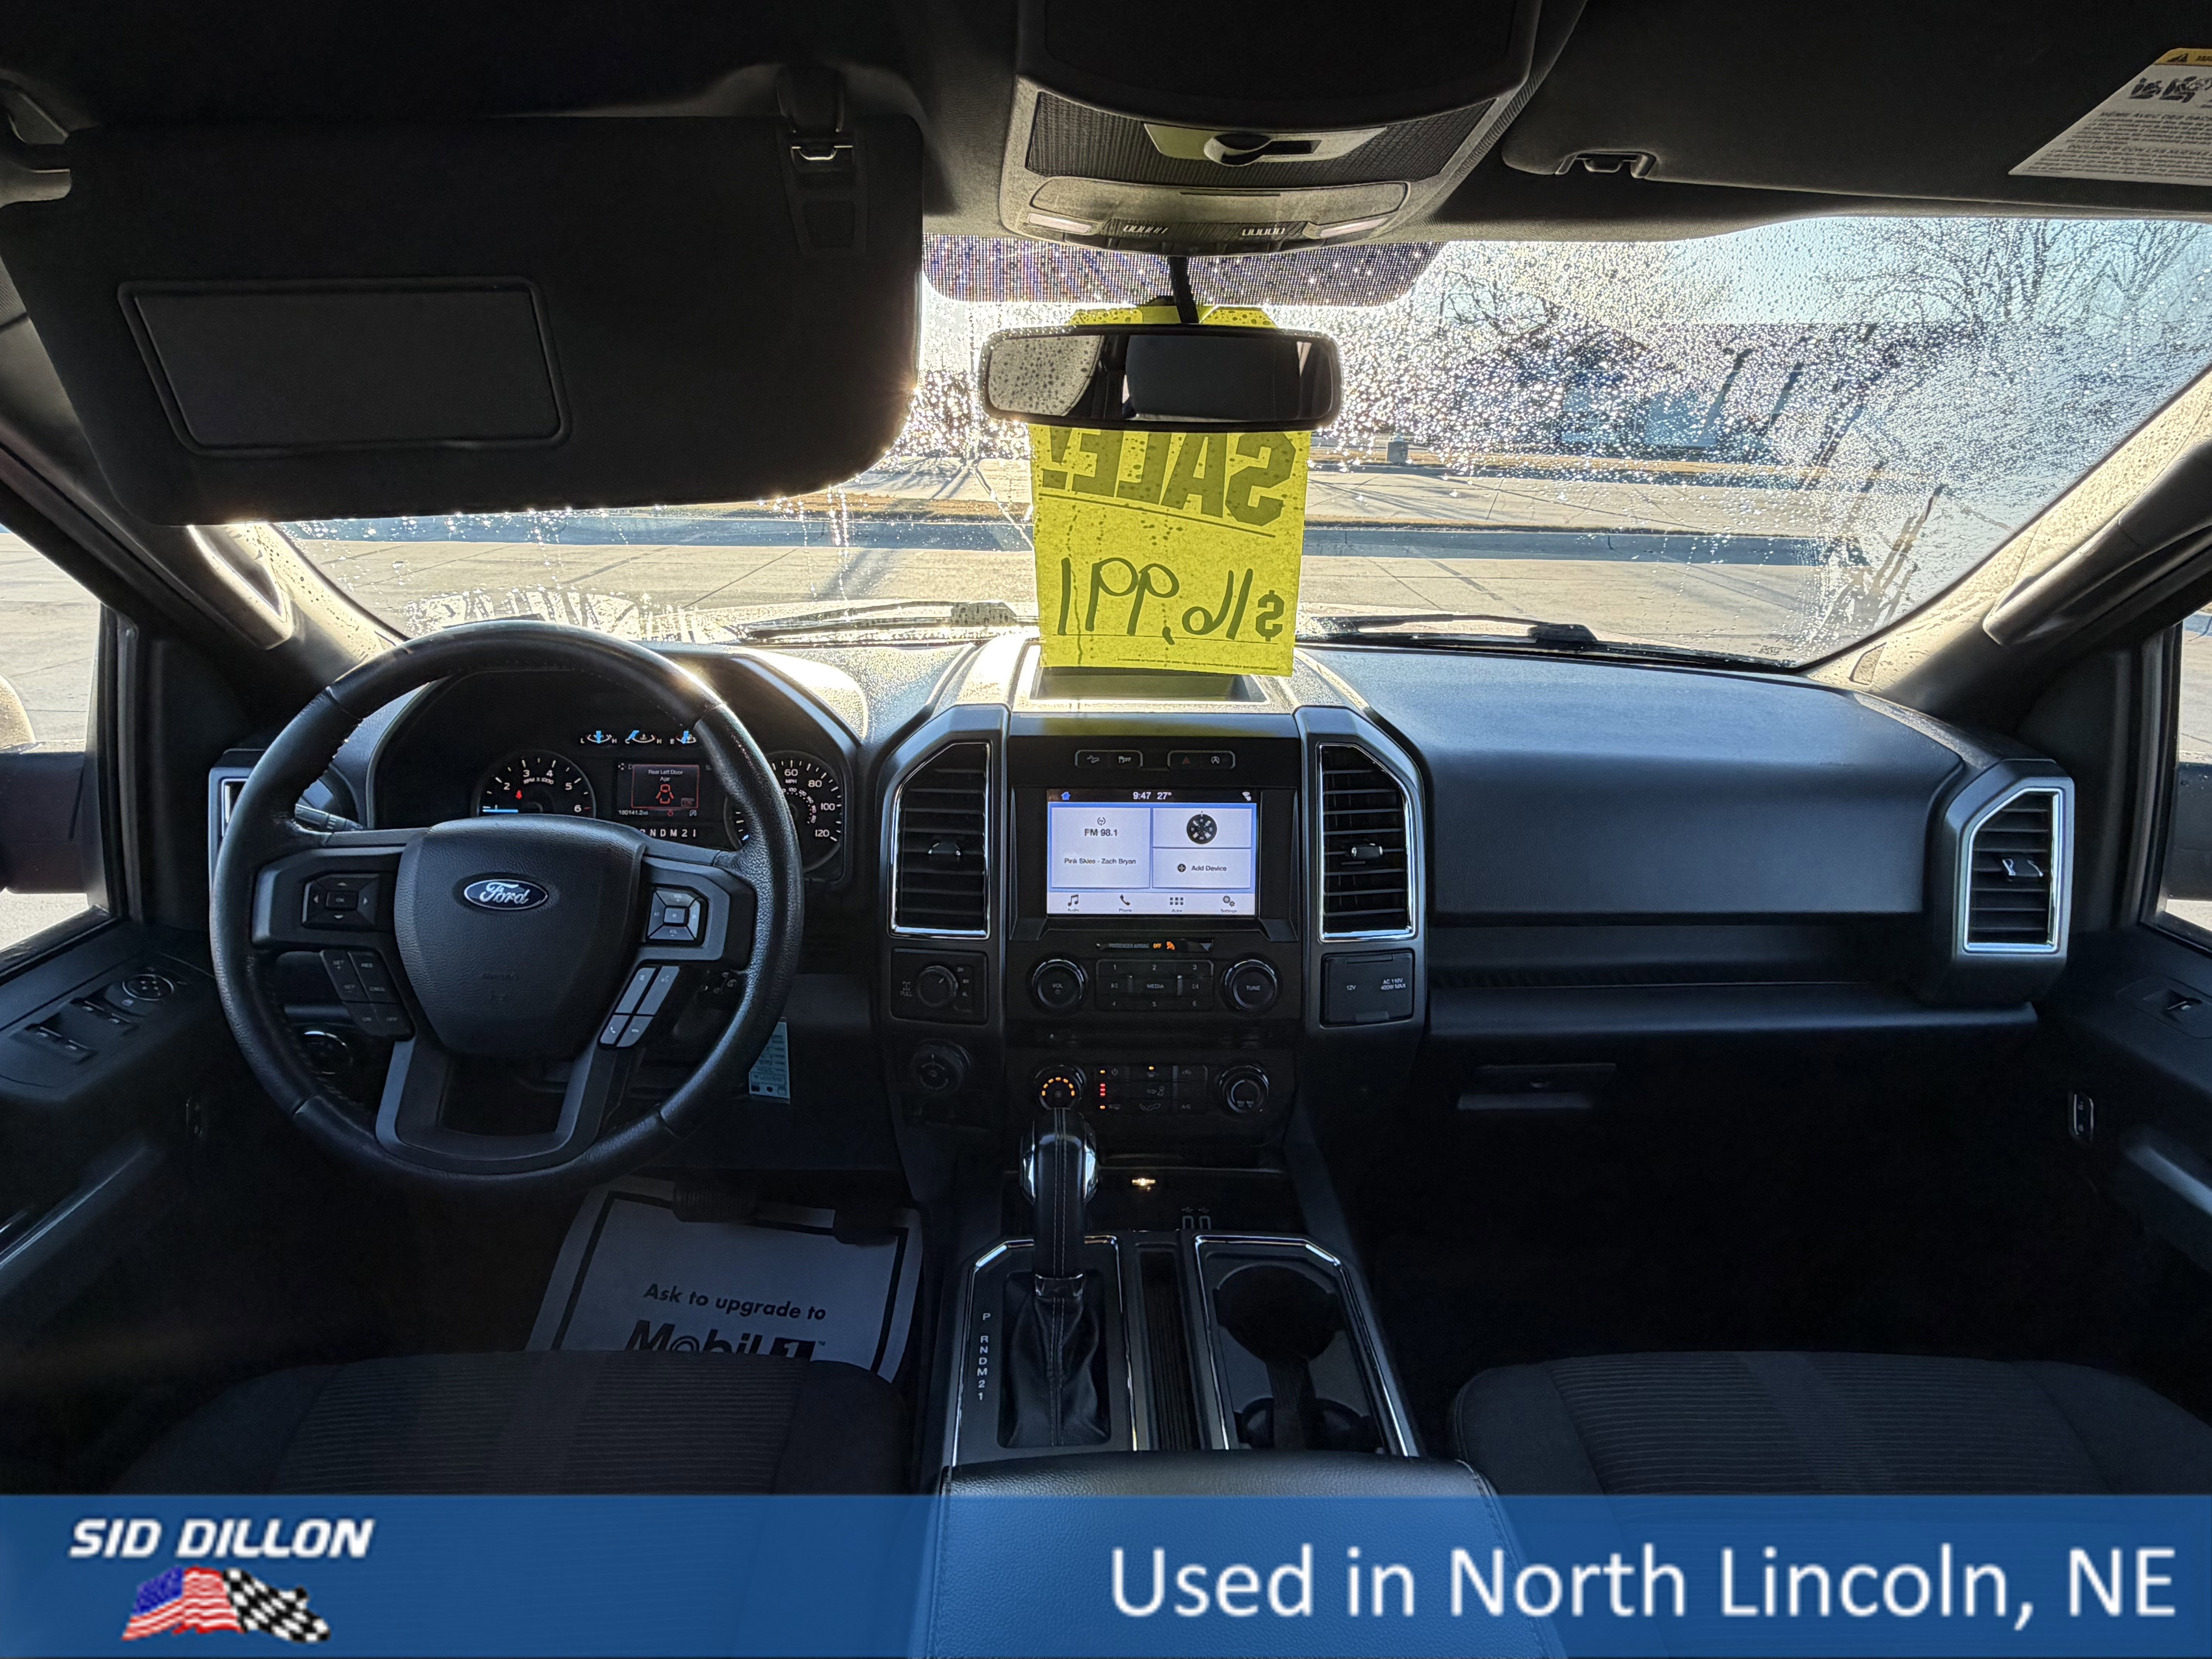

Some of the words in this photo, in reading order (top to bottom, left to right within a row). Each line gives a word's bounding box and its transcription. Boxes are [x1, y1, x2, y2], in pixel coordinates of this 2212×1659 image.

[808, 780, 822, 788] 80
[1133, 792, 1151, 800] 9:47
[1157, 792, 1172, 800] 27°
[821, 803, 835, 811] 100
[650, 829, 656, 837] N
[660, 829, 666, 837] D
[670, 829, 677, 837] M
[681, 829, 688, 837] 2
[815, 829, 830, 837] 120
[1084, 828, 1098, 836] FM
[1100, 828, 1118, 836] 98.1
[479, 882, 531, 905] Ford
[643, 1283, 683, 1303] Ask
[689, 1291, 708, 1306] to
[715, 1298, 801, 1319] upgrade
[807, 1306, 826, 1320] to
[980, 1346, 988, 1354] N
[979, 1357, 988, 1365] D
[977, 1368, 988, 1376] M
[978, 1379, 986, 1388] 2
[978, 1392, 983, 1400] 1
